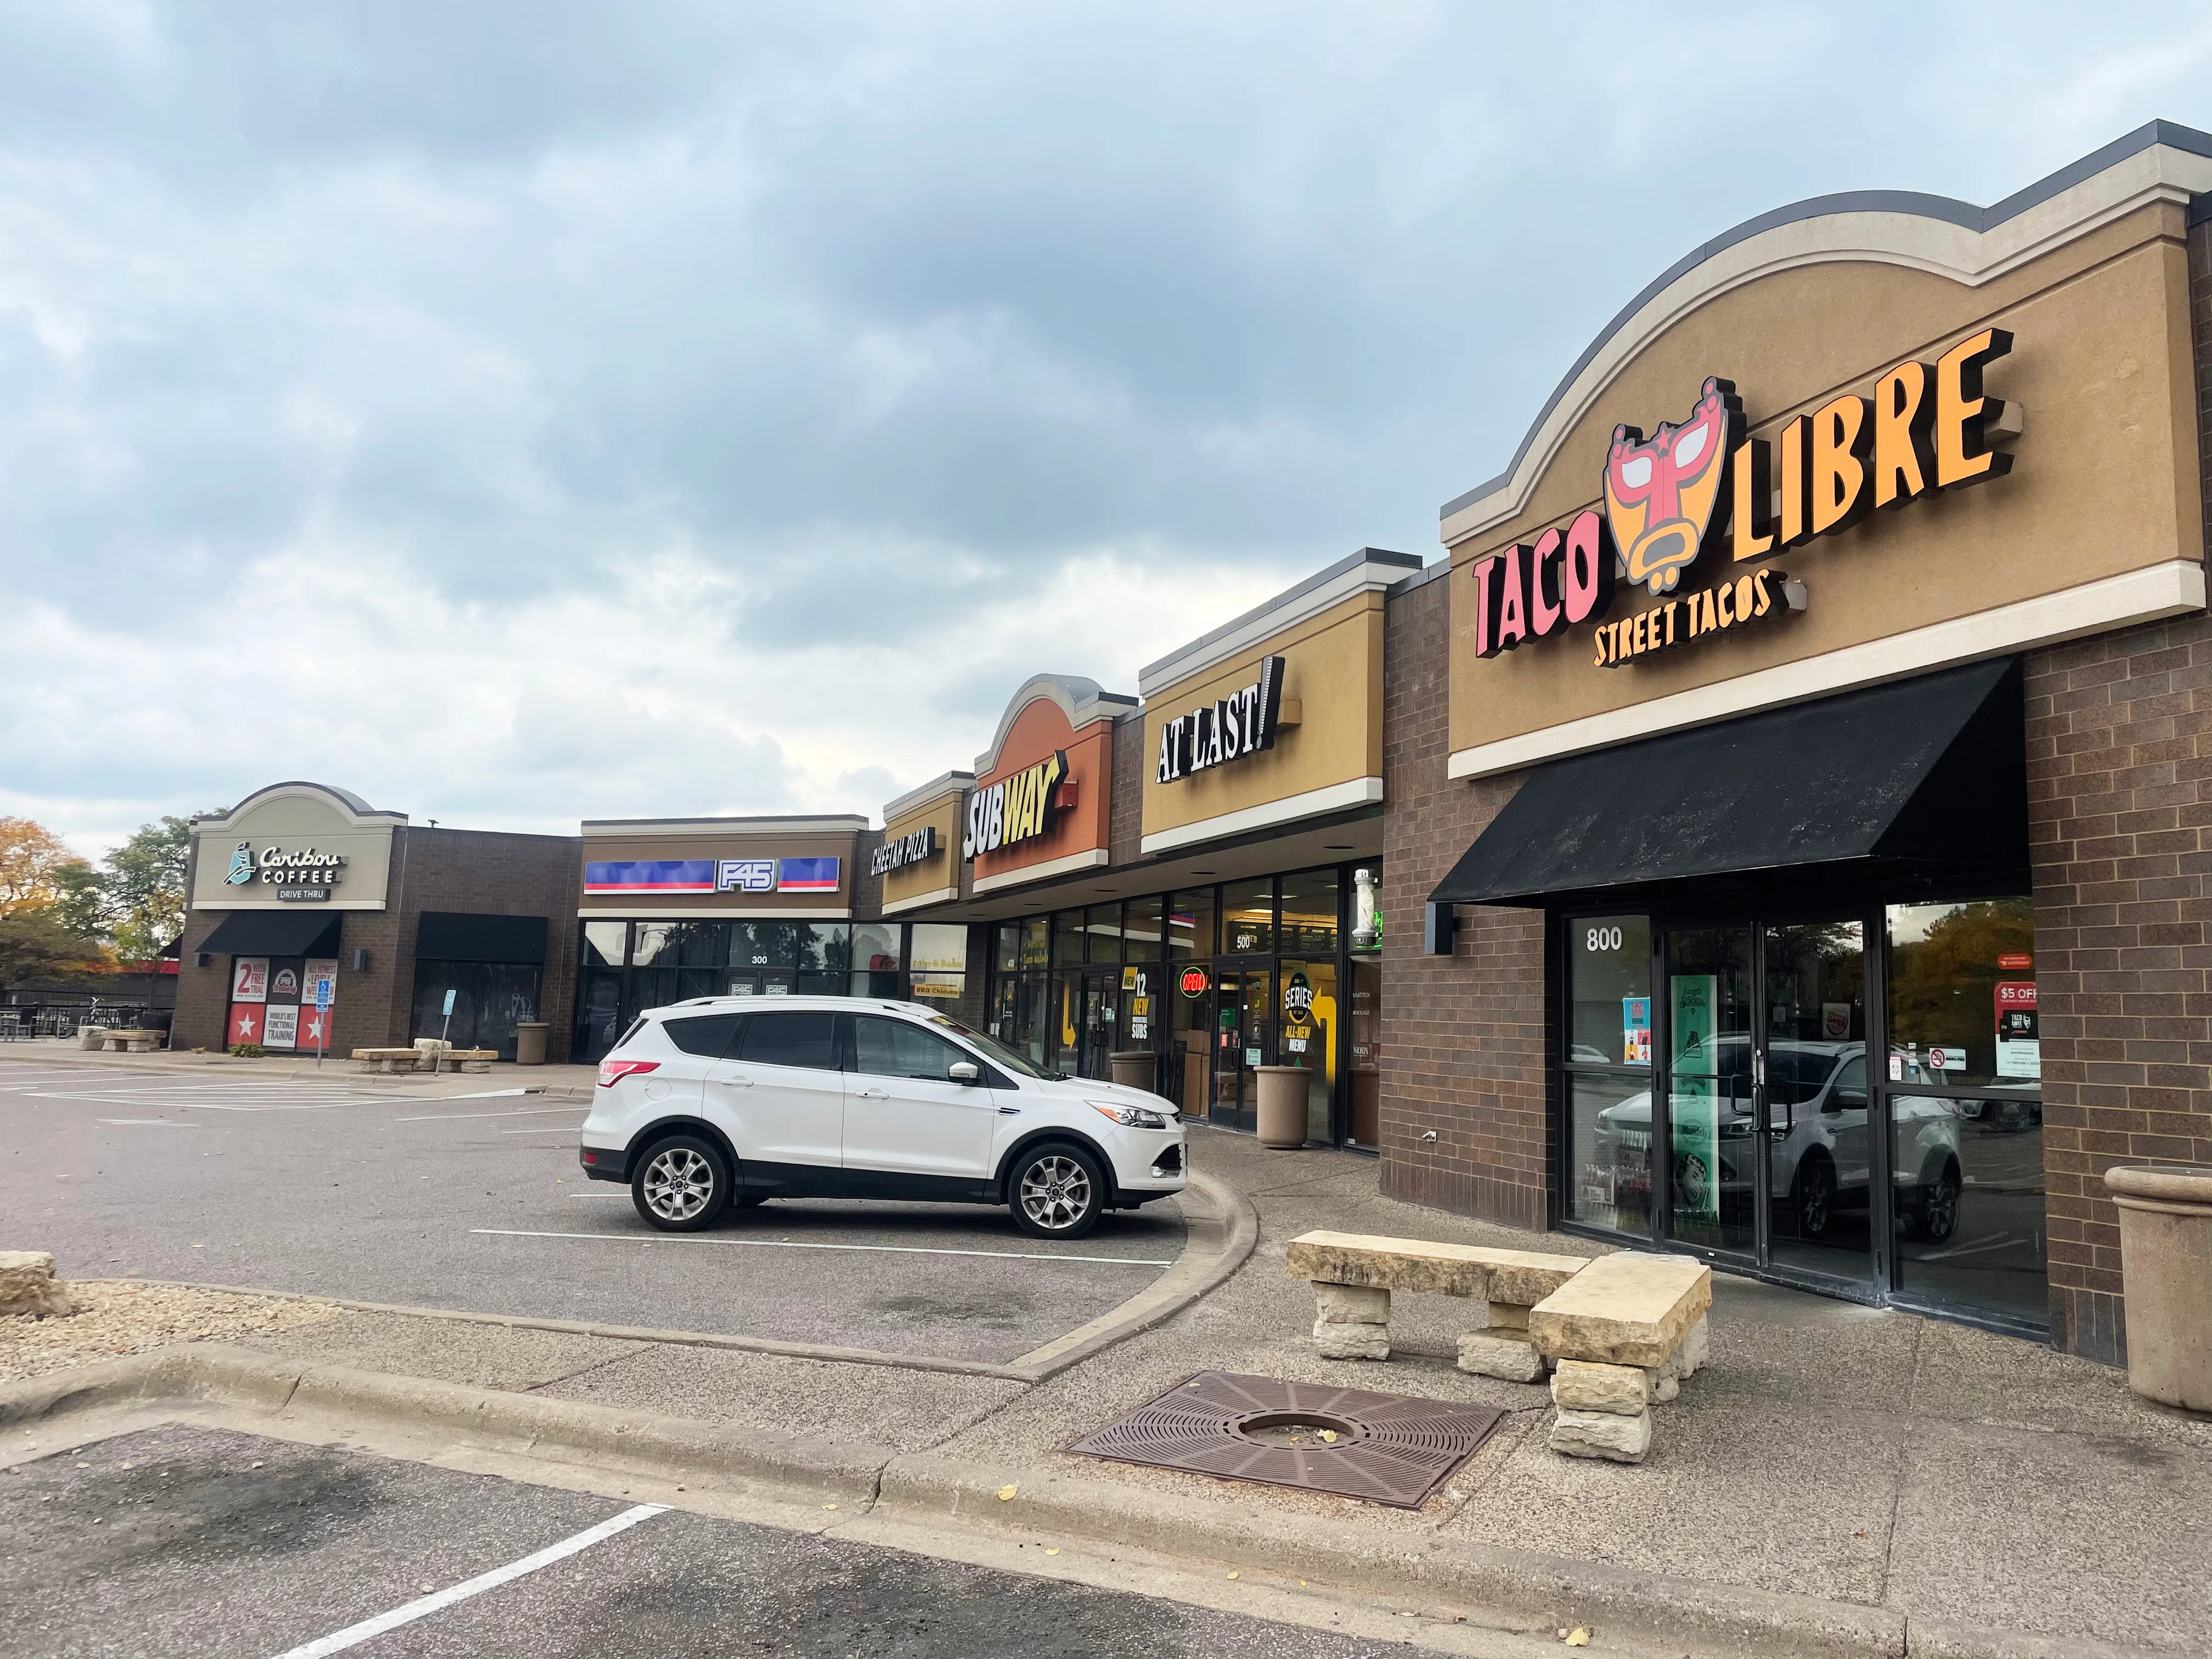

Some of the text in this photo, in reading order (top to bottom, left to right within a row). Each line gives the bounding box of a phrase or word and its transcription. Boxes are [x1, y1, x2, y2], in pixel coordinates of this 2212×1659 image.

[1472, 328, 1994, 658] TACO LIBRE
[1593, 568, 1770, 668] STREET TACOS
[1155, 715, 1185, 785] AT
[962, 751, 1060, 862] SUBWAY
[259, 846, 339, 868] Caribou
[871, 827, 928, 876] CHEETAH PIZZA
[262, 870, 334, 884] COFFEE
[720, 861, 773, 889] F45
[280, 890, 324, 899] DRIVE THRU
[1237, 934, 1250, 949] 500
[1587, 926, 1622, 952] 800
[752, 956, 768, 964] 300
[237, 963, 252, 993] 2
[318, 966, 336, 974] FITNESS
[251, 973, 266, 985] FREE
[1136, 973, 1147, 997] 12
[1182, 974, 1203, 991] OPEN
[250, 985, 263, 994] TRIAL
[2001, 987, 2016, 1000] $5
[1132, 998, 1149, 1016] NEW
[1285, 986, 1313, 1011] SERIES
[268, 1020, 295, 1030] FUNCTIONAL
[1131, 1023, 1148, 1040] SUBS
[1285, 1025, 1312, 1040] ALL-NEW
[268, 1030, 294, 1041] TRAINING
[1288, 1039, 1307, 1053] MENU
